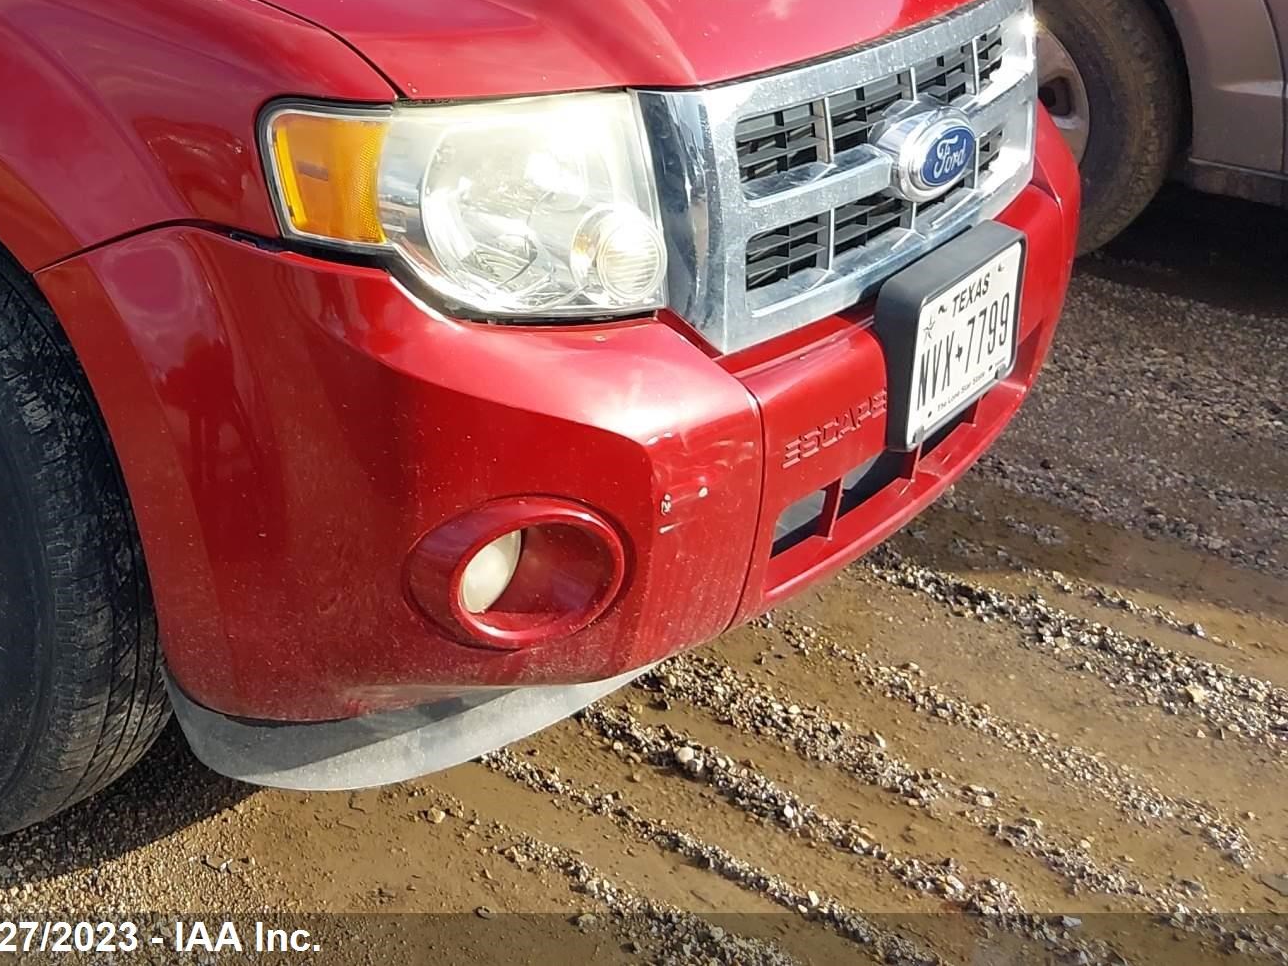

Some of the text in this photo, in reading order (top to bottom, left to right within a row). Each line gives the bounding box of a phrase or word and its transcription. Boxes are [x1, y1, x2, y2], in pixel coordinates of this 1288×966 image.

[933, 134, 967, 179] Ford
[952, 271, 991, 318] TEXAS
[782, 386, 888, 469] ESCAPE
